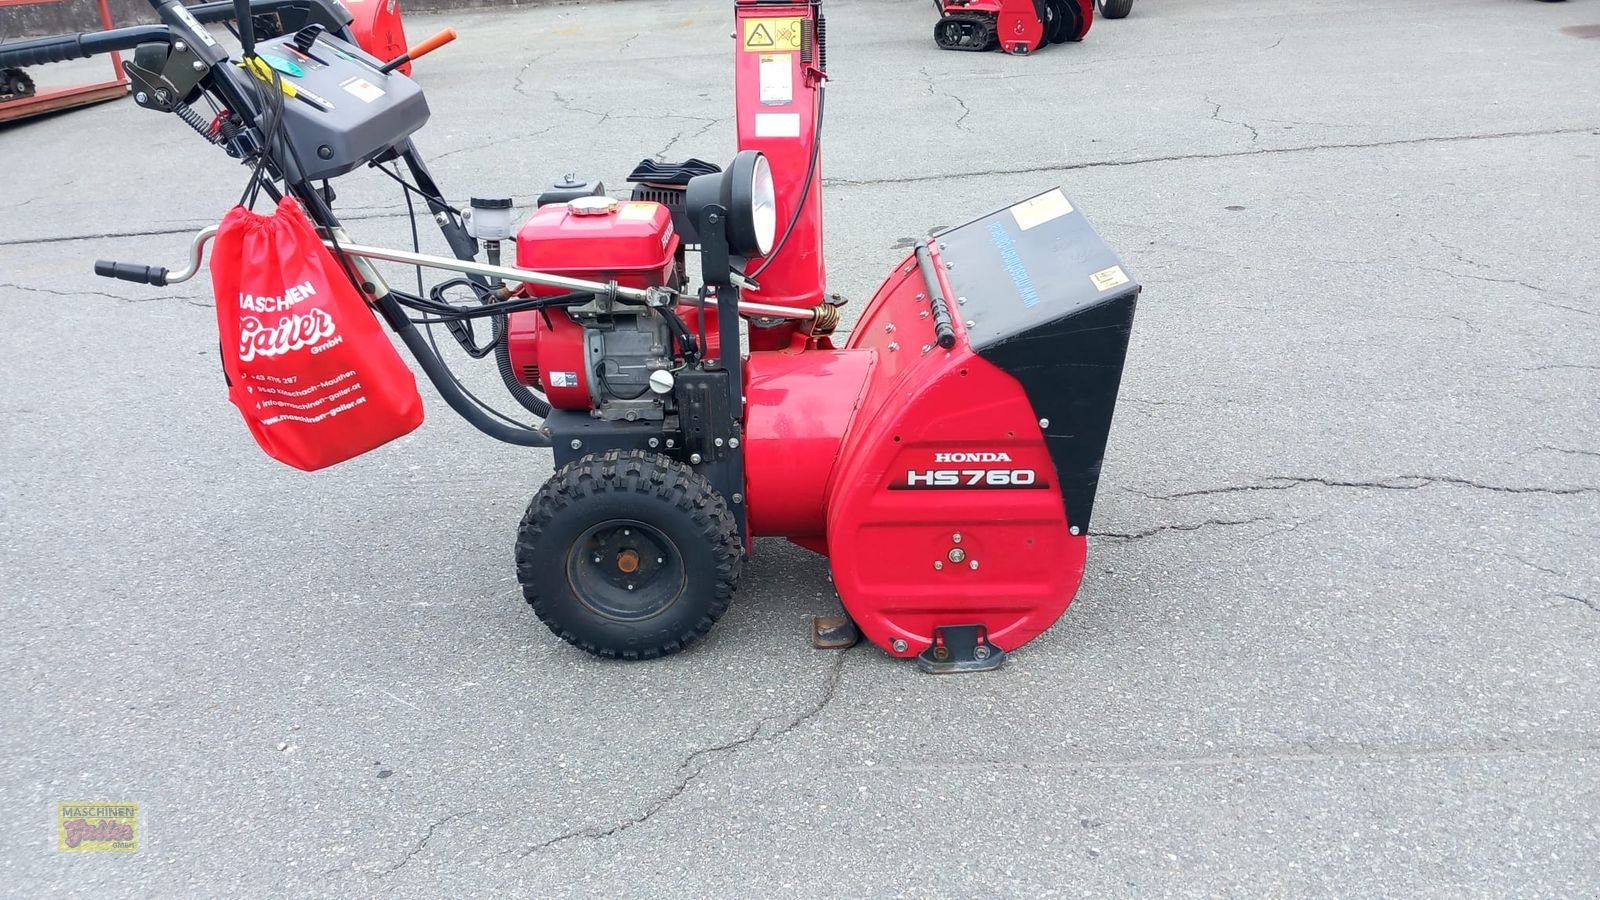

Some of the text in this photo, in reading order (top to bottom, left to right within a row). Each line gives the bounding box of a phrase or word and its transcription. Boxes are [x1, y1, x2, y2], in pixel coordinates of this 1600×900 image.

[239, 280, 317, 313] ASCHEN
[239, 307, 336, 363] Gailer
[310, 335, 343, 355] GmbH
[282, 376, 297, 384] 297
[934, 452, 1012, 463] HONDA
[907, 469, 1036, 486] HS760
